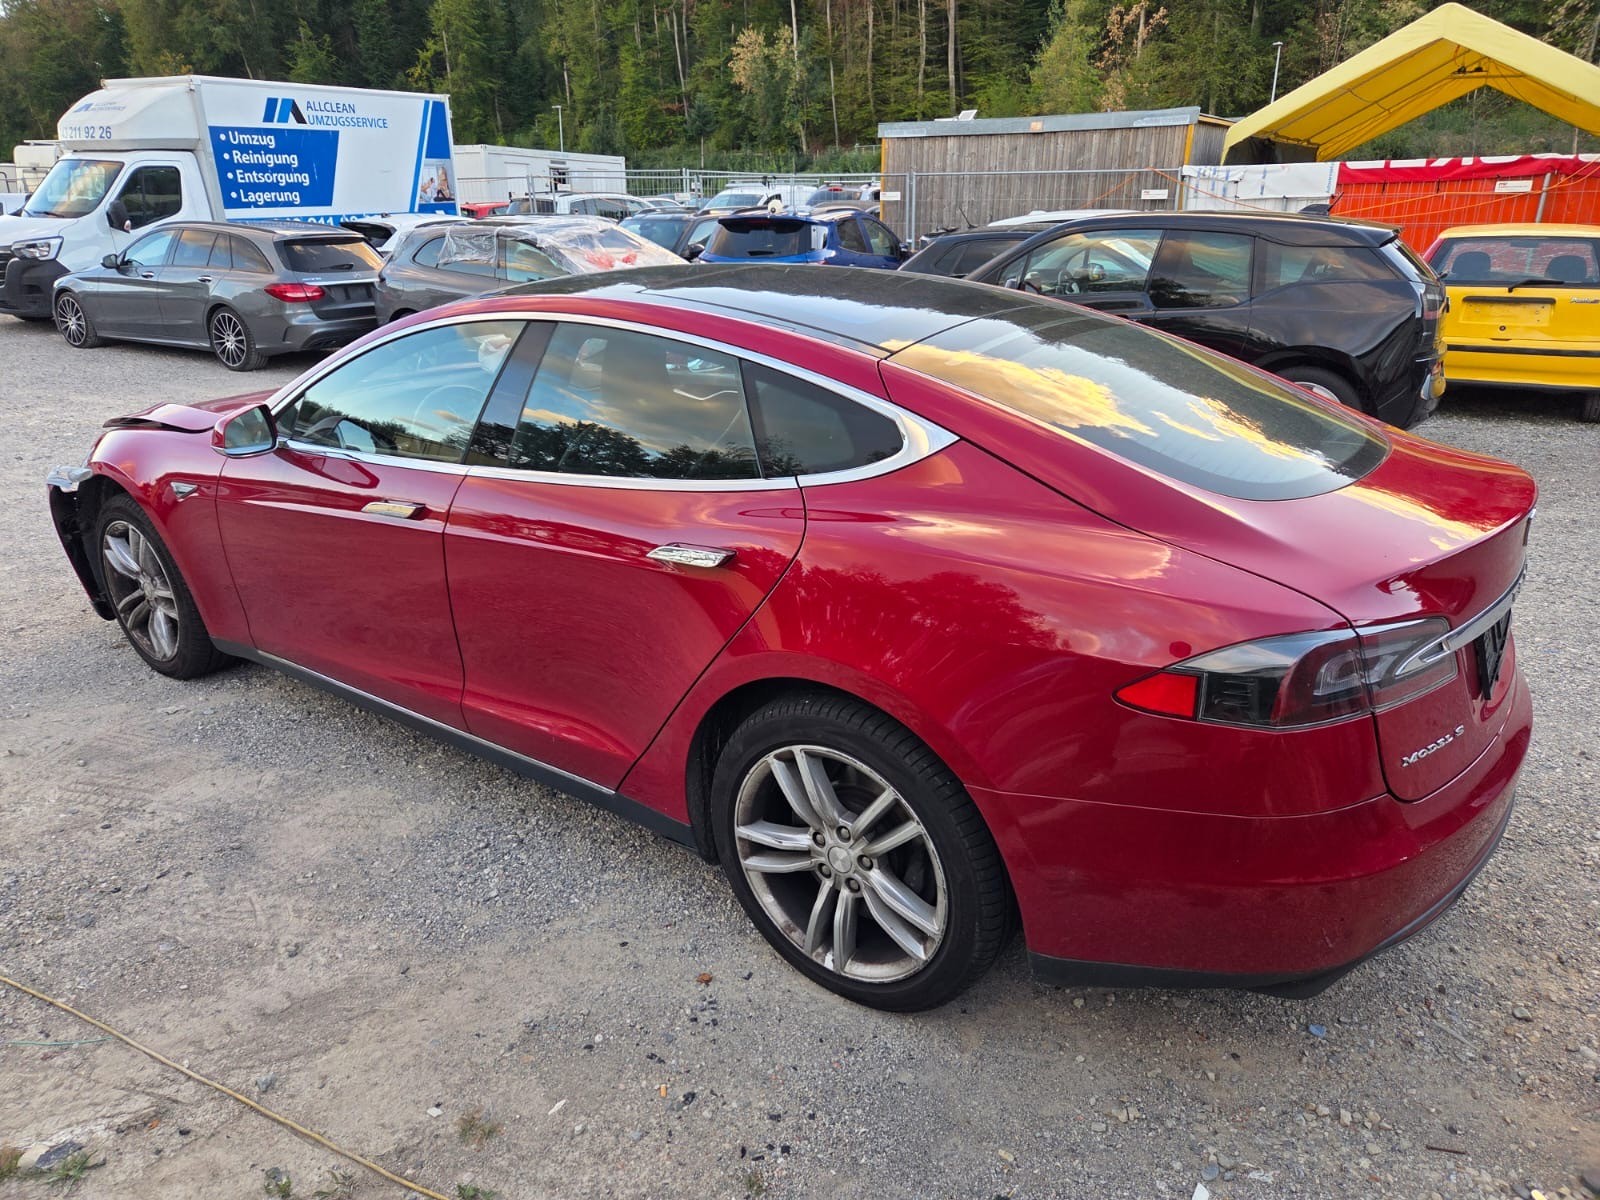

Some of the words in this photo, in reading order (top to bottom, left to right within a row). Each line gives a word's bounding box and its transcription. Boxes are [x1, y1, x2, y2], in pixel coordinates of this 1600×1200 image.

[306, 100, 356, 114] ALLCLEAN
[307, 114, 389, 128] UMZUGSSERVICE
[85, 126, 96, 139] 92
[99, 125, 112, 139] 26
[228, 130, 275, 149] Umzug
[232, 150, 298, 168] Reinigung
[236, 169, 310, 186] Entsorgung
[240, 189, 301, 205] Lagerung
[1402, 733, 1454, 767] MODEL
[1454, 724, 1465, 737] S
